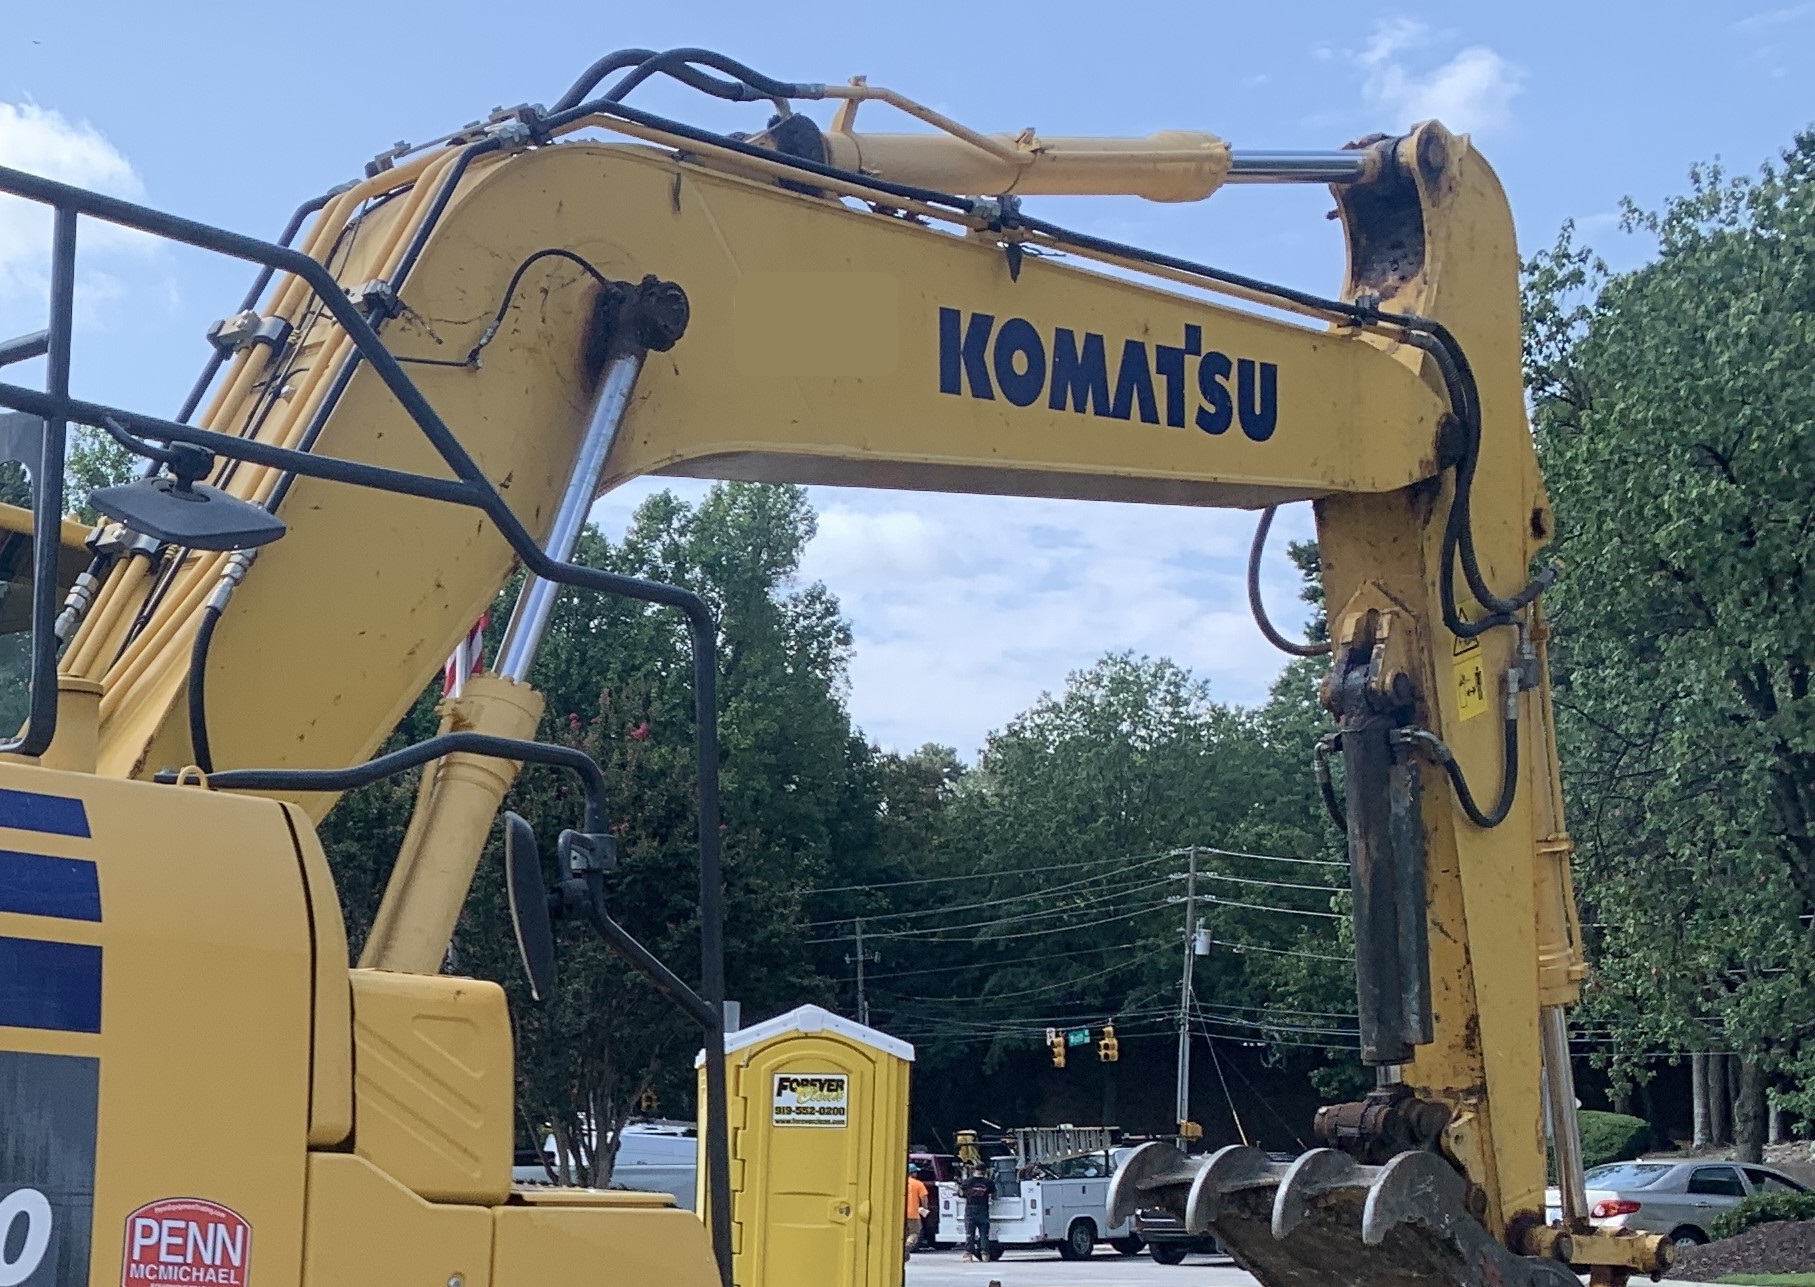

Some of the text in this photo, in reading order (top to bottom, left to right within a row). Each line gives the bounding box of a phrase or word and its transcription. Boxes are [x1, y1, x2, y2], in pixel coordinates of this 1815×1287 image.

[938, 306, 1278, 442] KOMATSU
[776, 1077, 845, 1097] FOREVER
[132, 1217, 244, 1267] PENN
[129, 1263, 240, 1285] MCMICHAEL
